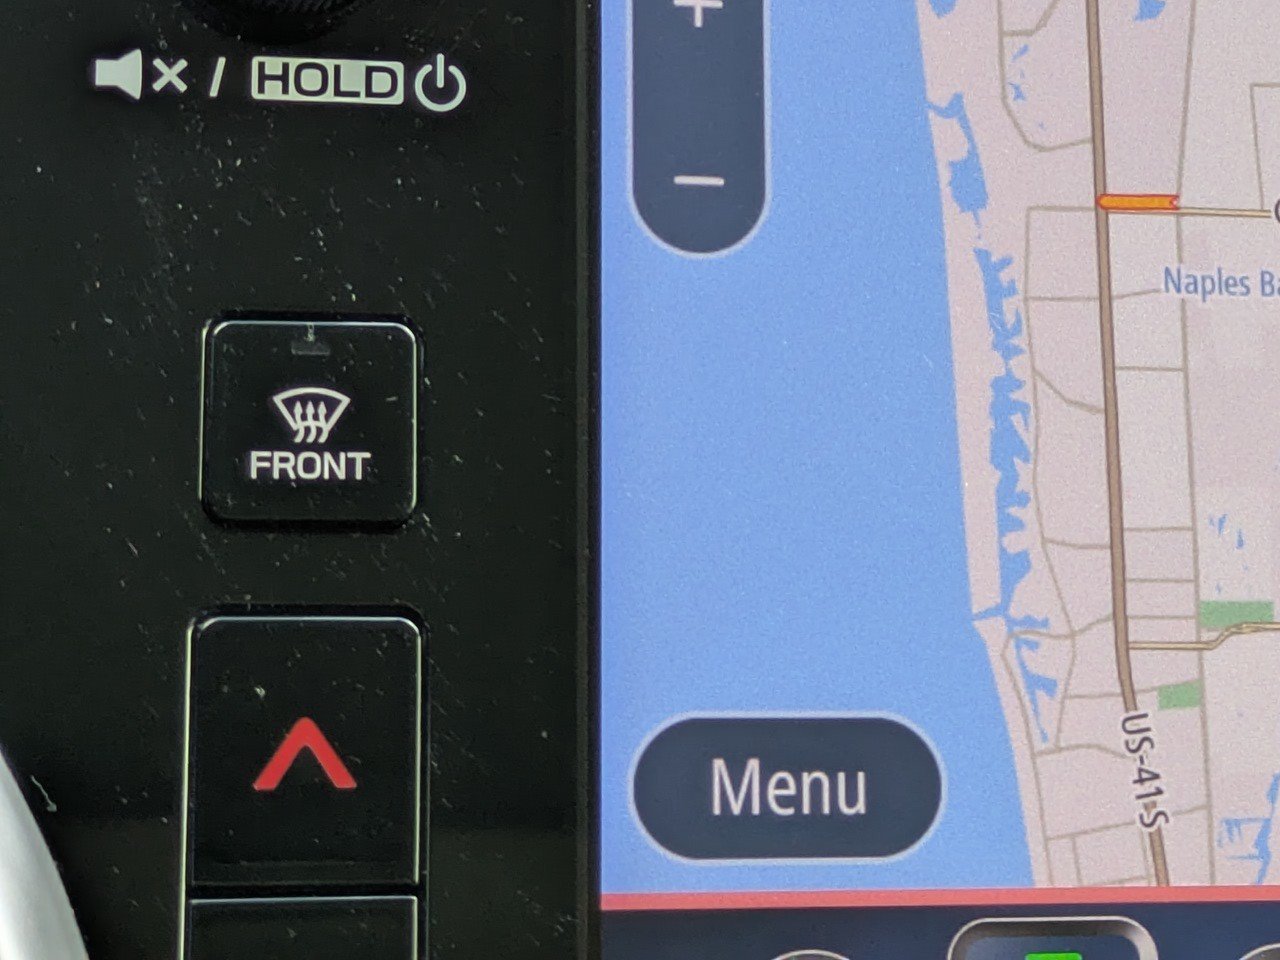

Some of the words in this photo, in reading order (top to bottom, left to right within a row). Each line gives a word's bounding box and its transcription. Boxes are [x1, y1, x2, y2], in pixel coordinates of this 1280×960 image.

[256, 60, 400, 99] HOLD
[1163, 266, 1252, 303] Naples
[249, 449, 372, 481] FRONT
[1121, 712, 1165, 802] US-41
[711, 757, 867, 817] Menu
[1138, 807, 1170, 831] S
